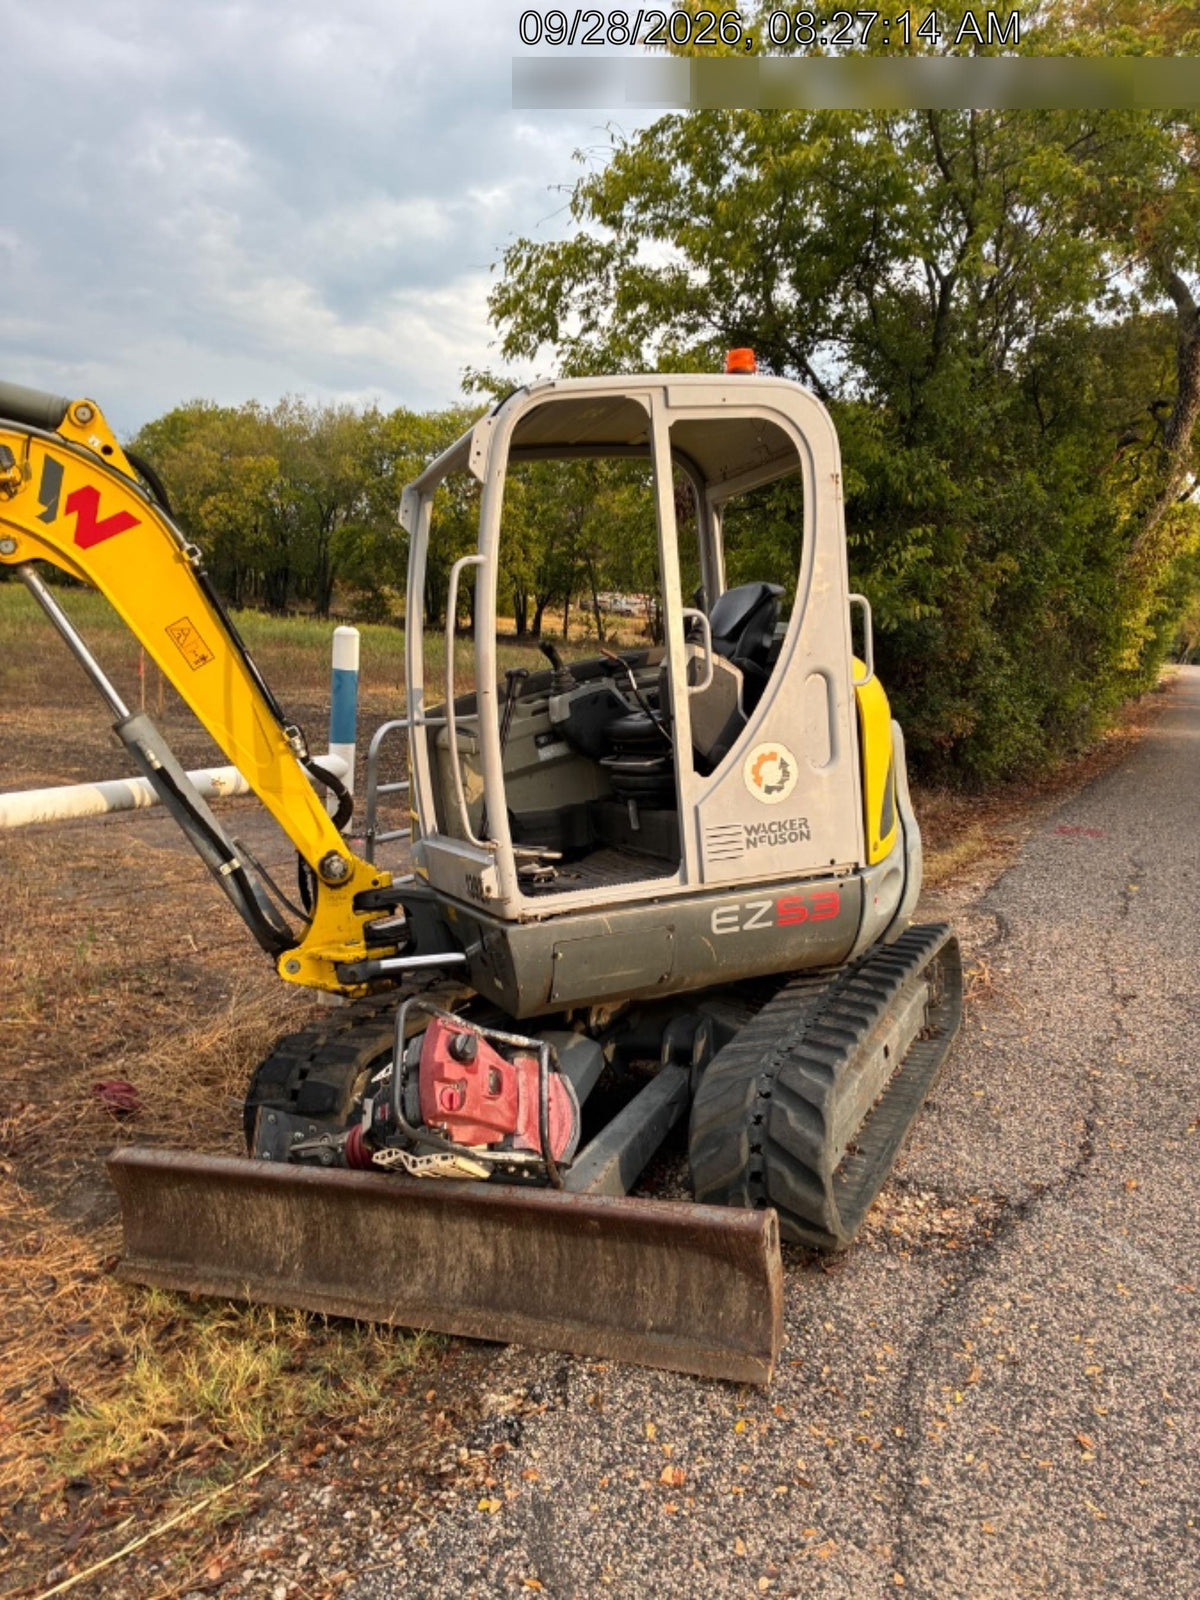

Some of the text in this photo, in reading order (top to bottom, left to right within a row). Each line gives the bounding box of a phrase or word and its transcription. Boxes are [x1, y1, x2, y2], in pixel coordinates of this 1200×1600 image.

[743, 817, 810, 836] WACKER
[745, 830, 812, 849] NEUSON
[711, 890, 841, 935] EZ53
